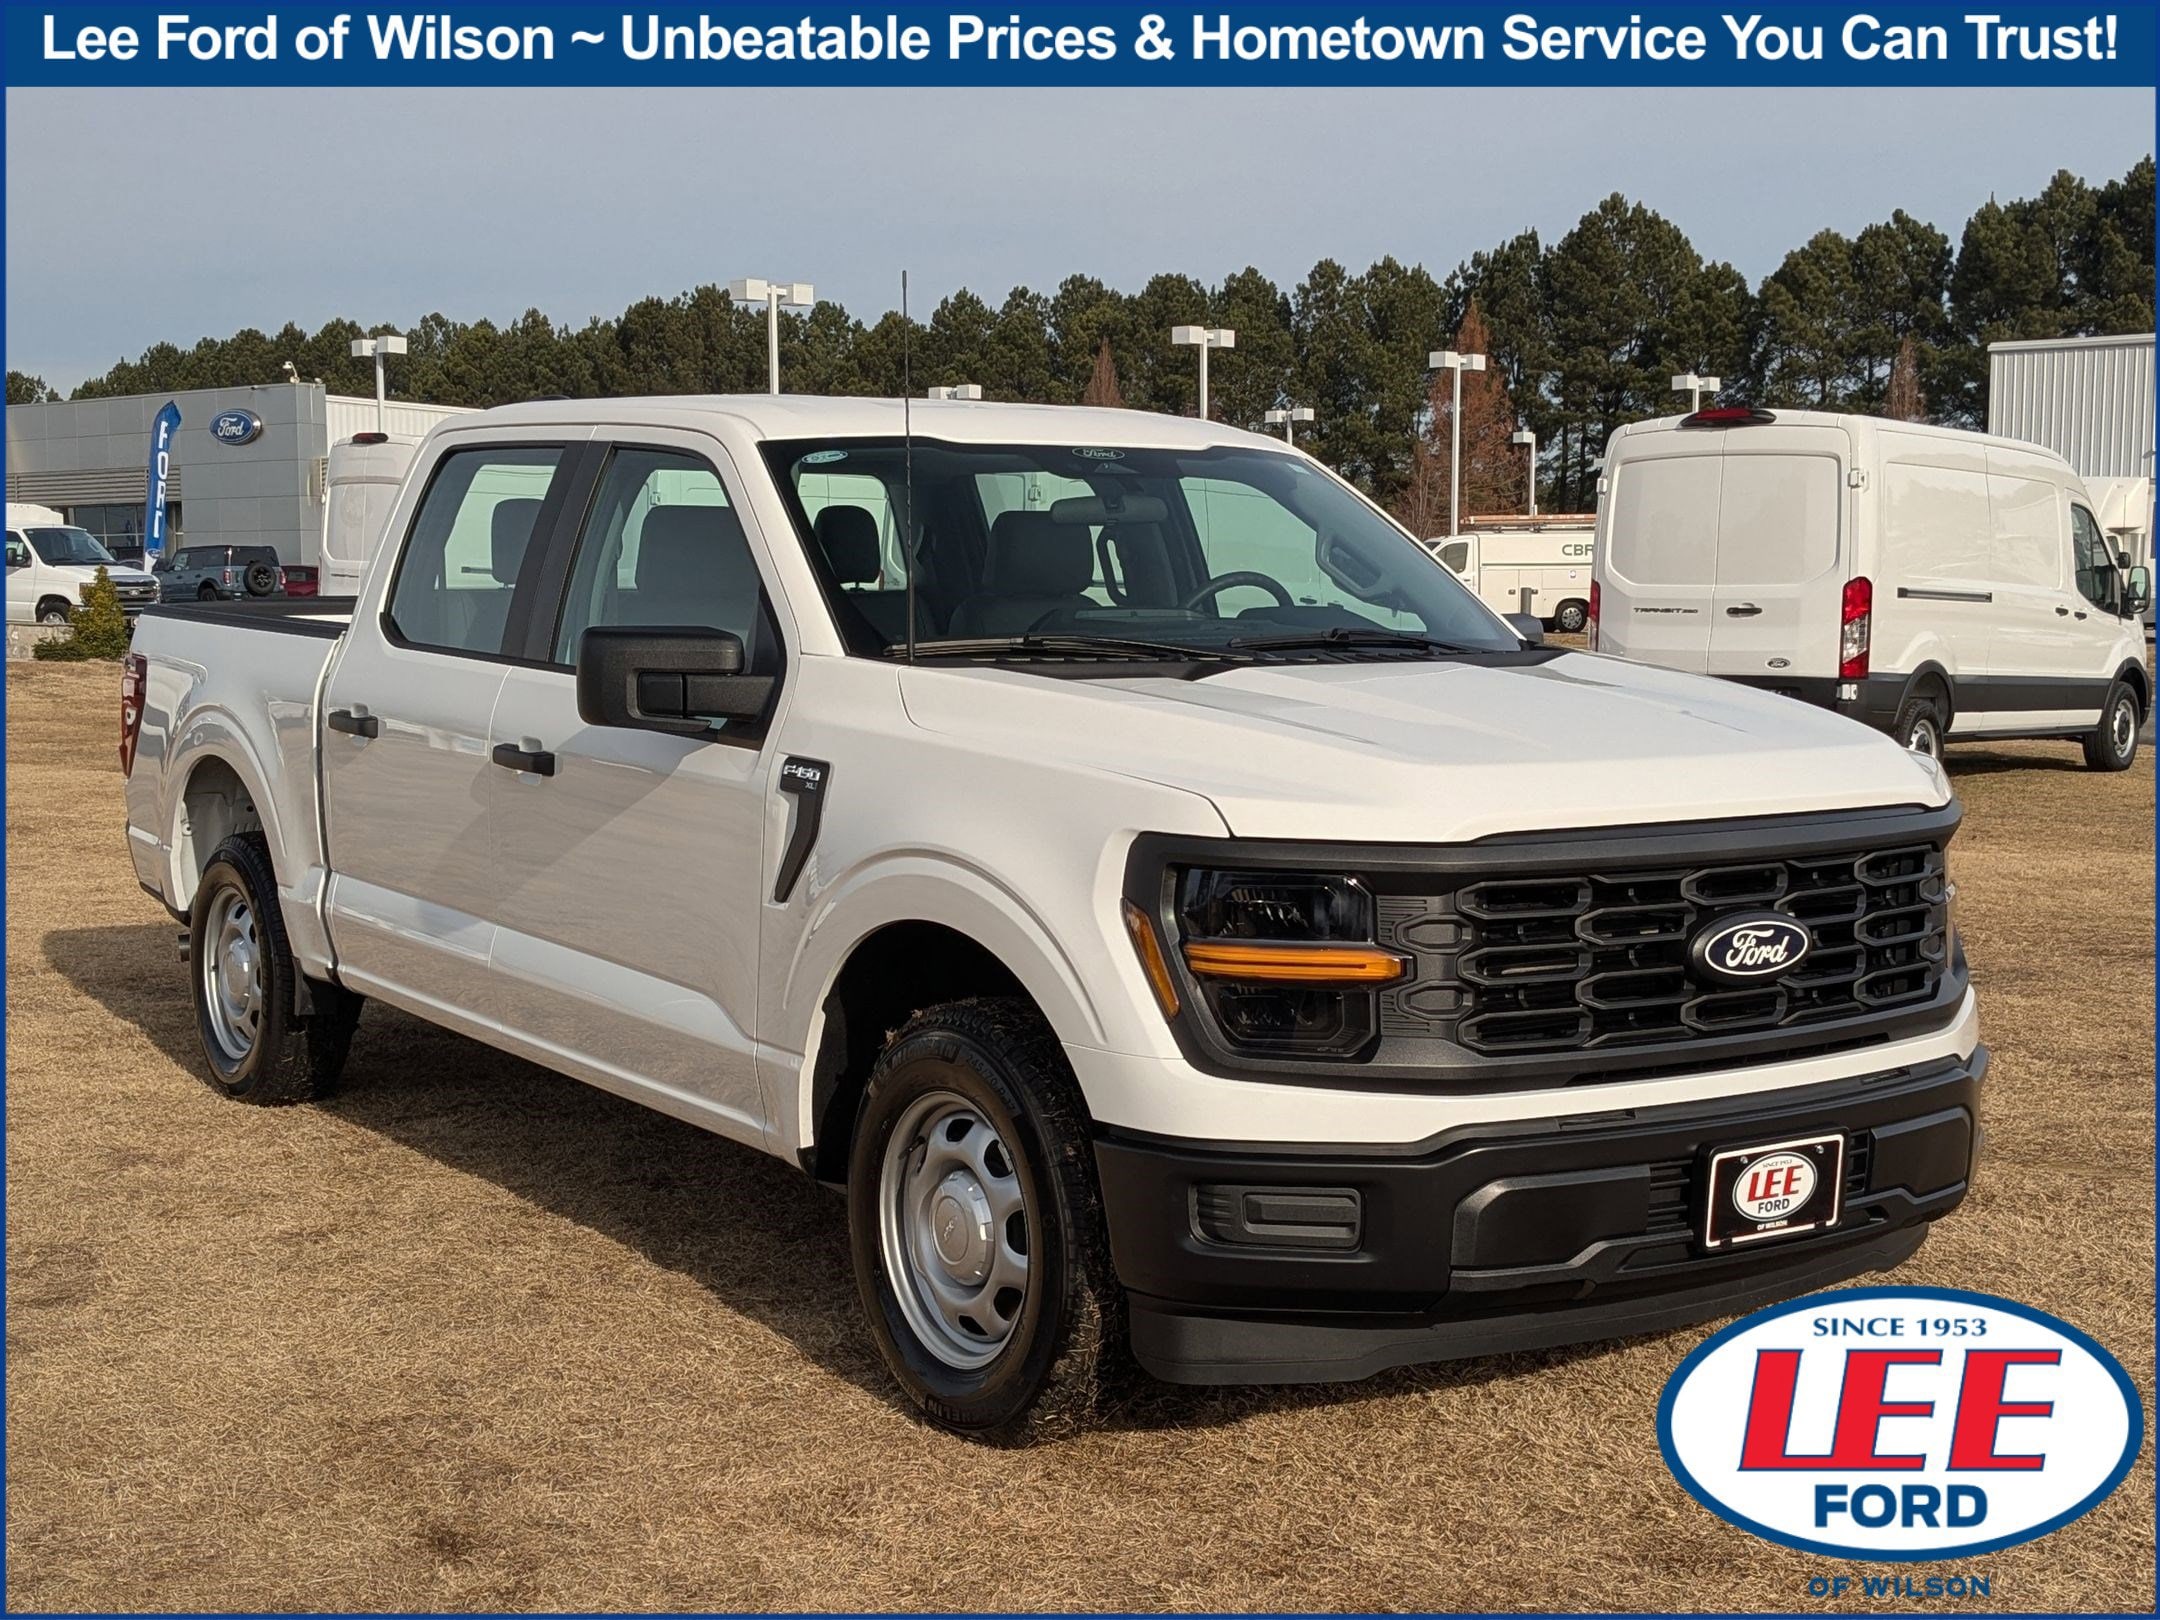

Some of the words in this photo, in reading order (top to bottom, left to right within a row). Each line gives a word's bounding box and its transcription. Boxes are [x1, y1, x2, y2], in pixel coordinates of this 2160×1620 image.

[217, 416, 245, 437] Ford
[1725, 928, 1790, 968] Ford
[1747, 1164, 1804, 1202] LEE
[1758, 1198, 1790, 1214] FORD
